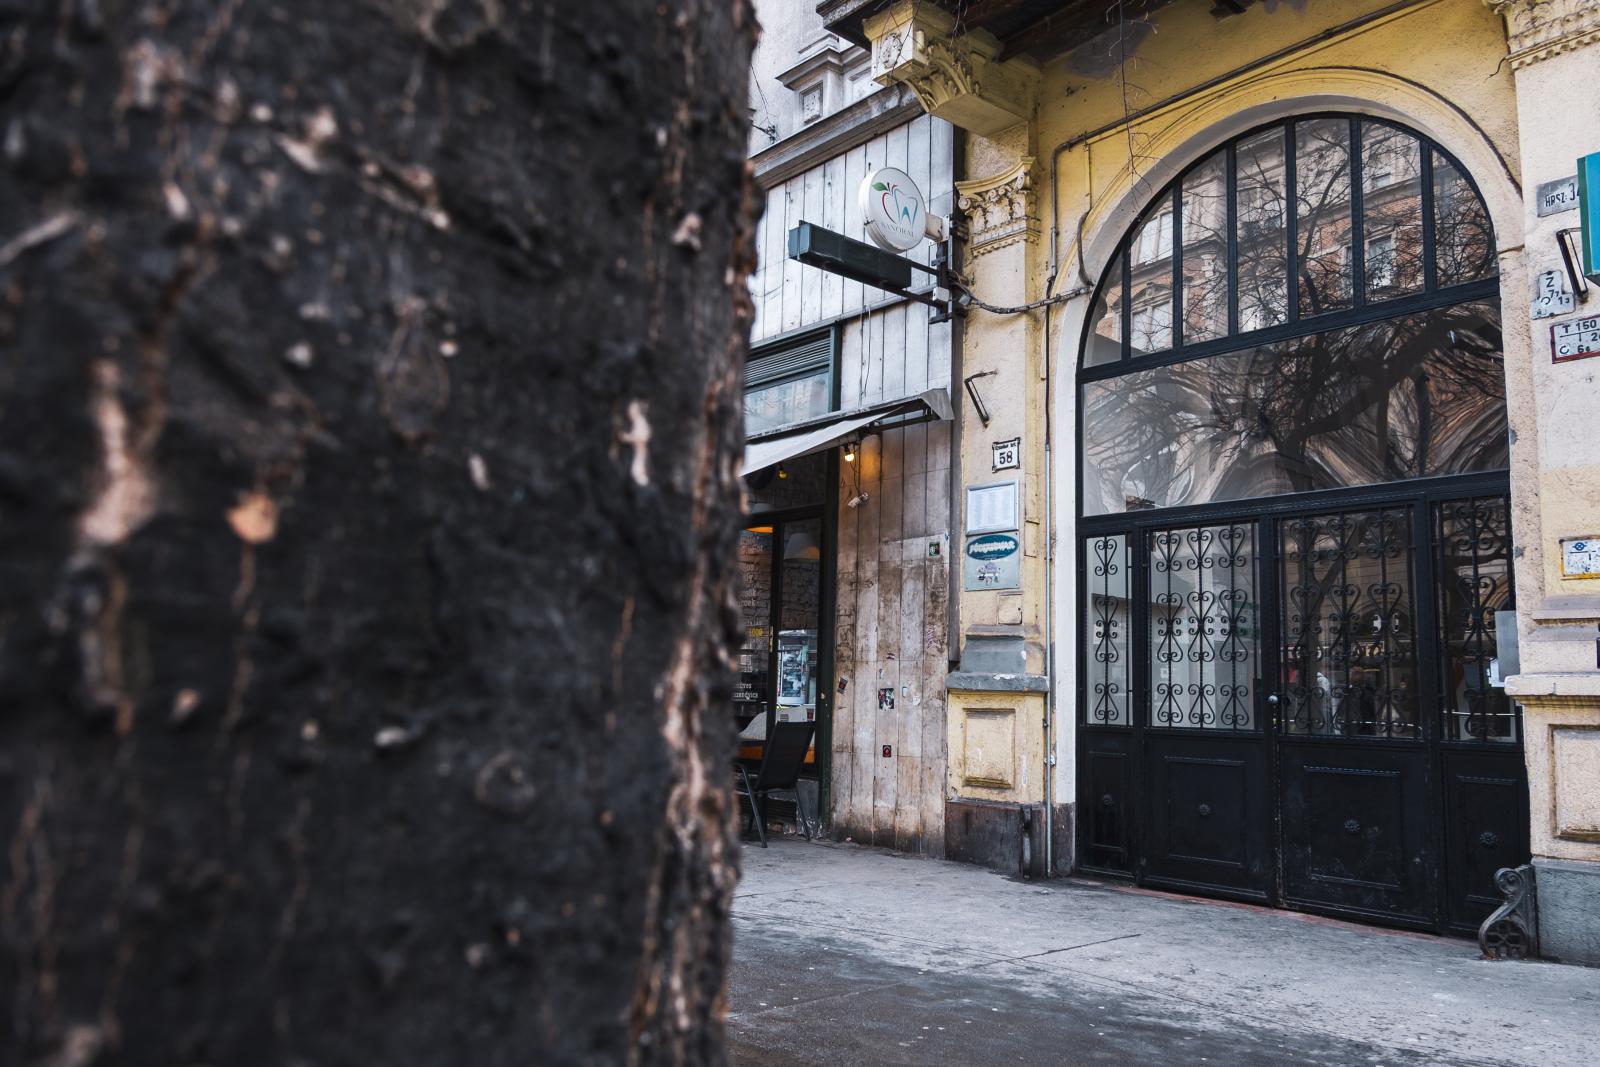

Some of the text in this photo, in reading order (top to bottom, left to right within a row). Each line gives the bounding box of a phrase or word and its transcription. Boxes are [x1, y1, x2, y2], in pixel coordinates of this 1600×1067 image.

[1545, 276, 1554, 288] Z
[1562, 319, 1597, 333] T 150
[1000, 450, 1013, 464] 58
